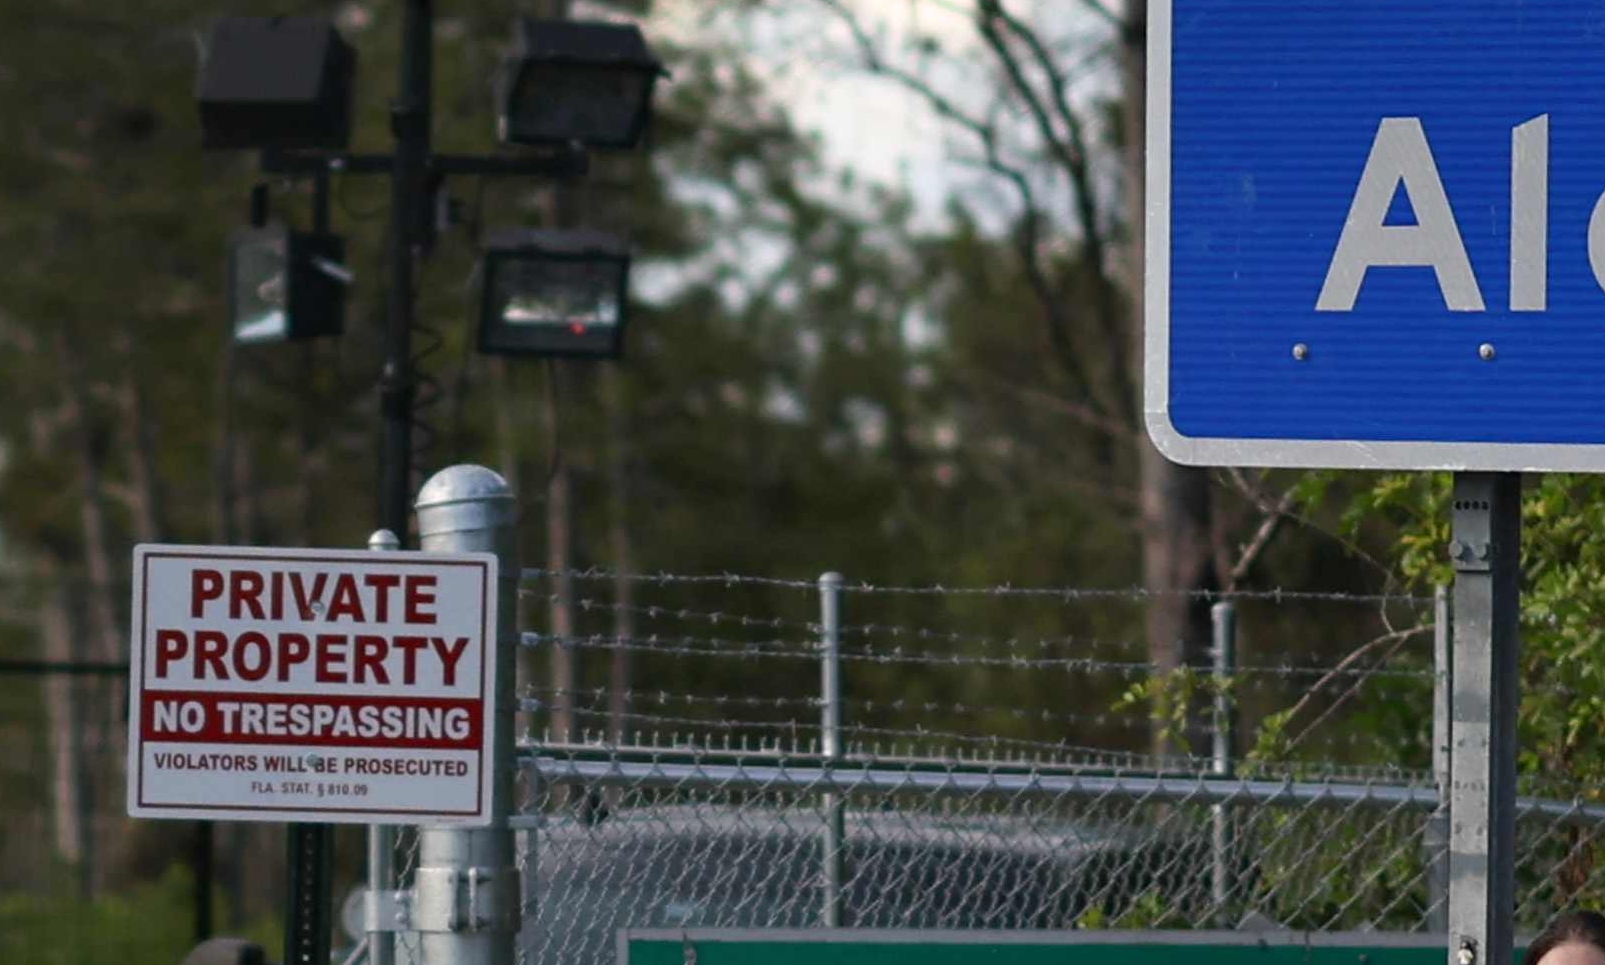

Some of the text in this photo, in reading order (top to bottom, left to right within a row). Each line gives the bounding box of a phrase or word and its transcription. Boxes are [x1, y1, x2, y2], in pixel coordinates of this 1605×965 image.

[191, 569, 437, 625] PRIVATE
[155, 629, 469, 686] PROPERTY
[153, 700, 470, 740] NO TRESPASSING
[154, 752, 469, 777] VIOLATORS WILL BE PROSECUTED
[281, 781, 314, 795] STAT.
[328, 783, 369, 796] 810.09
